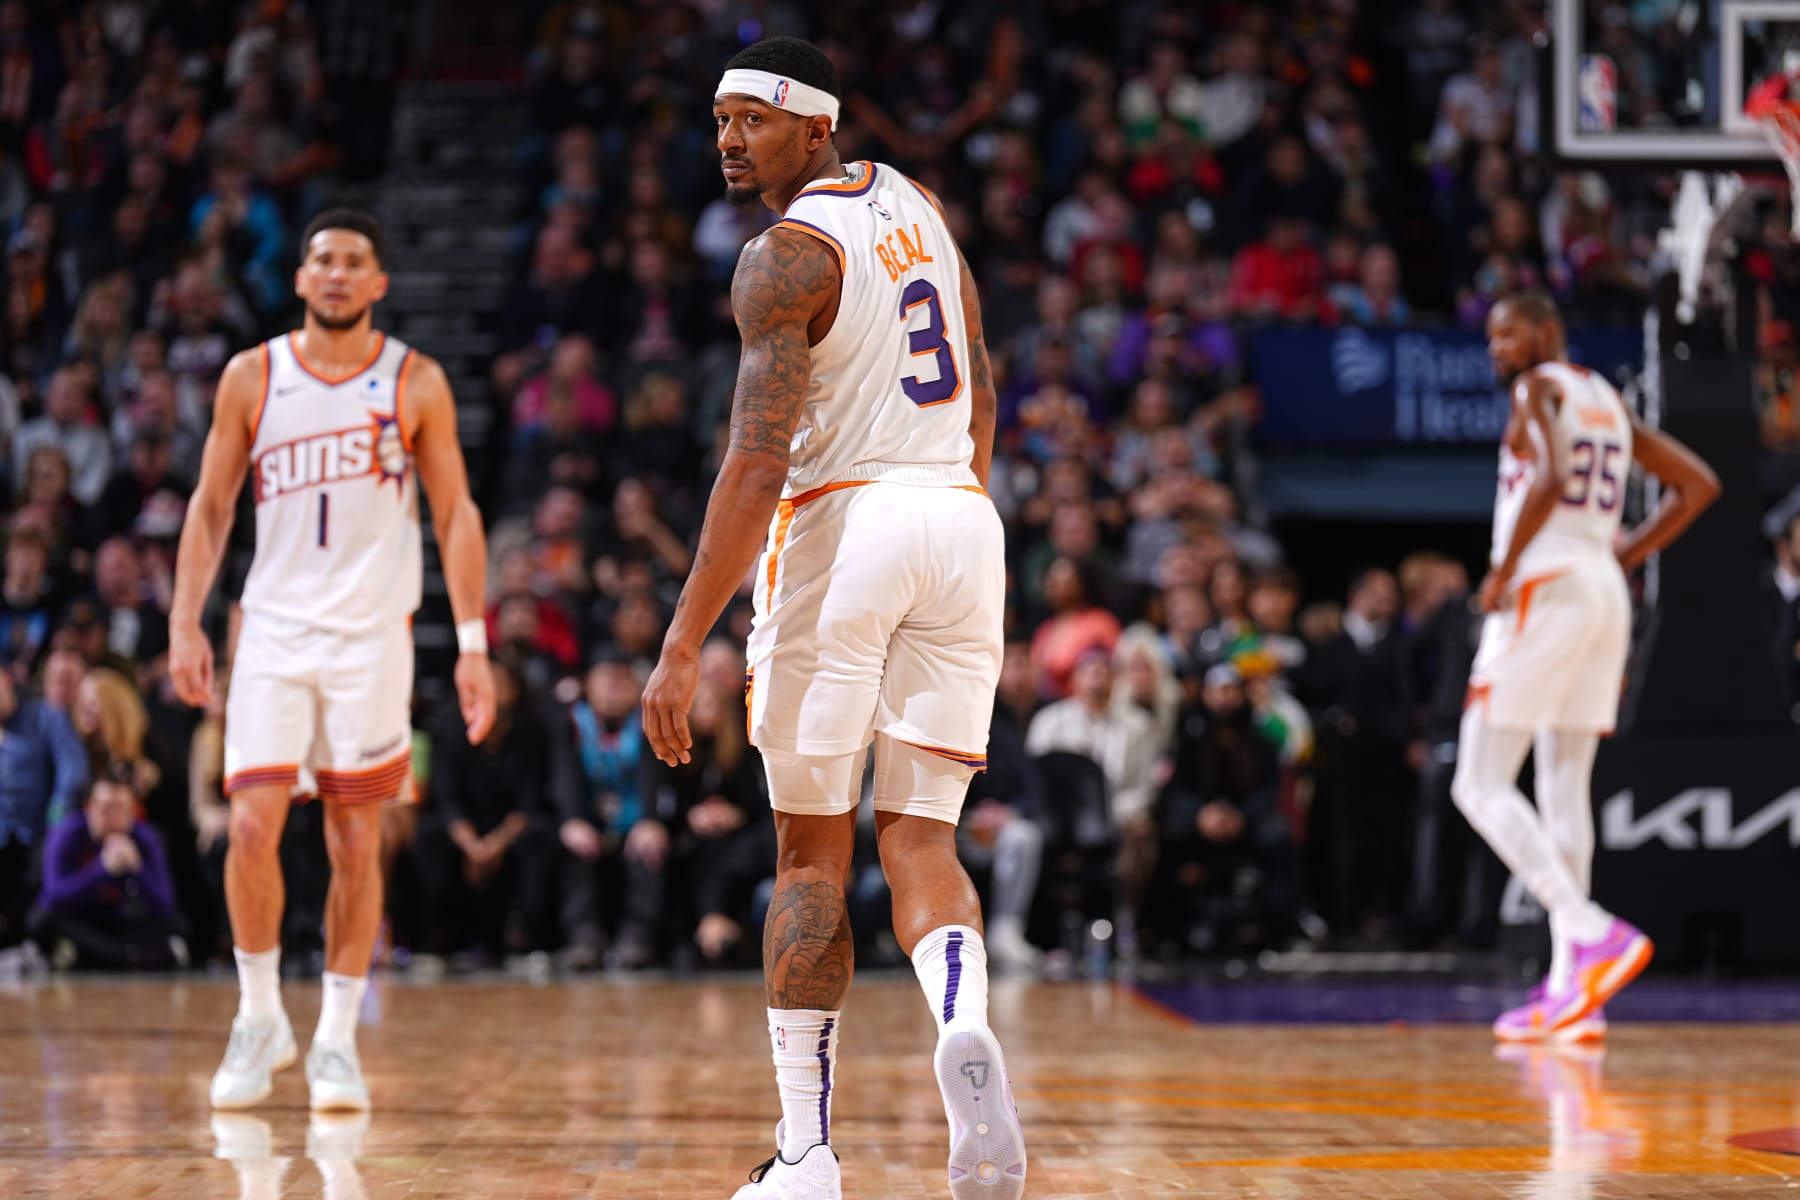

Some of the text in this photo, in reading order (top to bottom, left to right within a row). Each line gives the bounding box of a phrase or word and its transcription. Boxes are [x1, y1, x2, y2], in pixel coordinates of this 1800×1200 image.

[875, 224, 933, 283] BEAL
[900, 278, 963, 408] 3
[1396, 391, 1511, 440] Heal
[259, 428, 373, 499] SUNS
[1561, 438, 1622, 512] 35
[317, 492, 328, 547] 1
